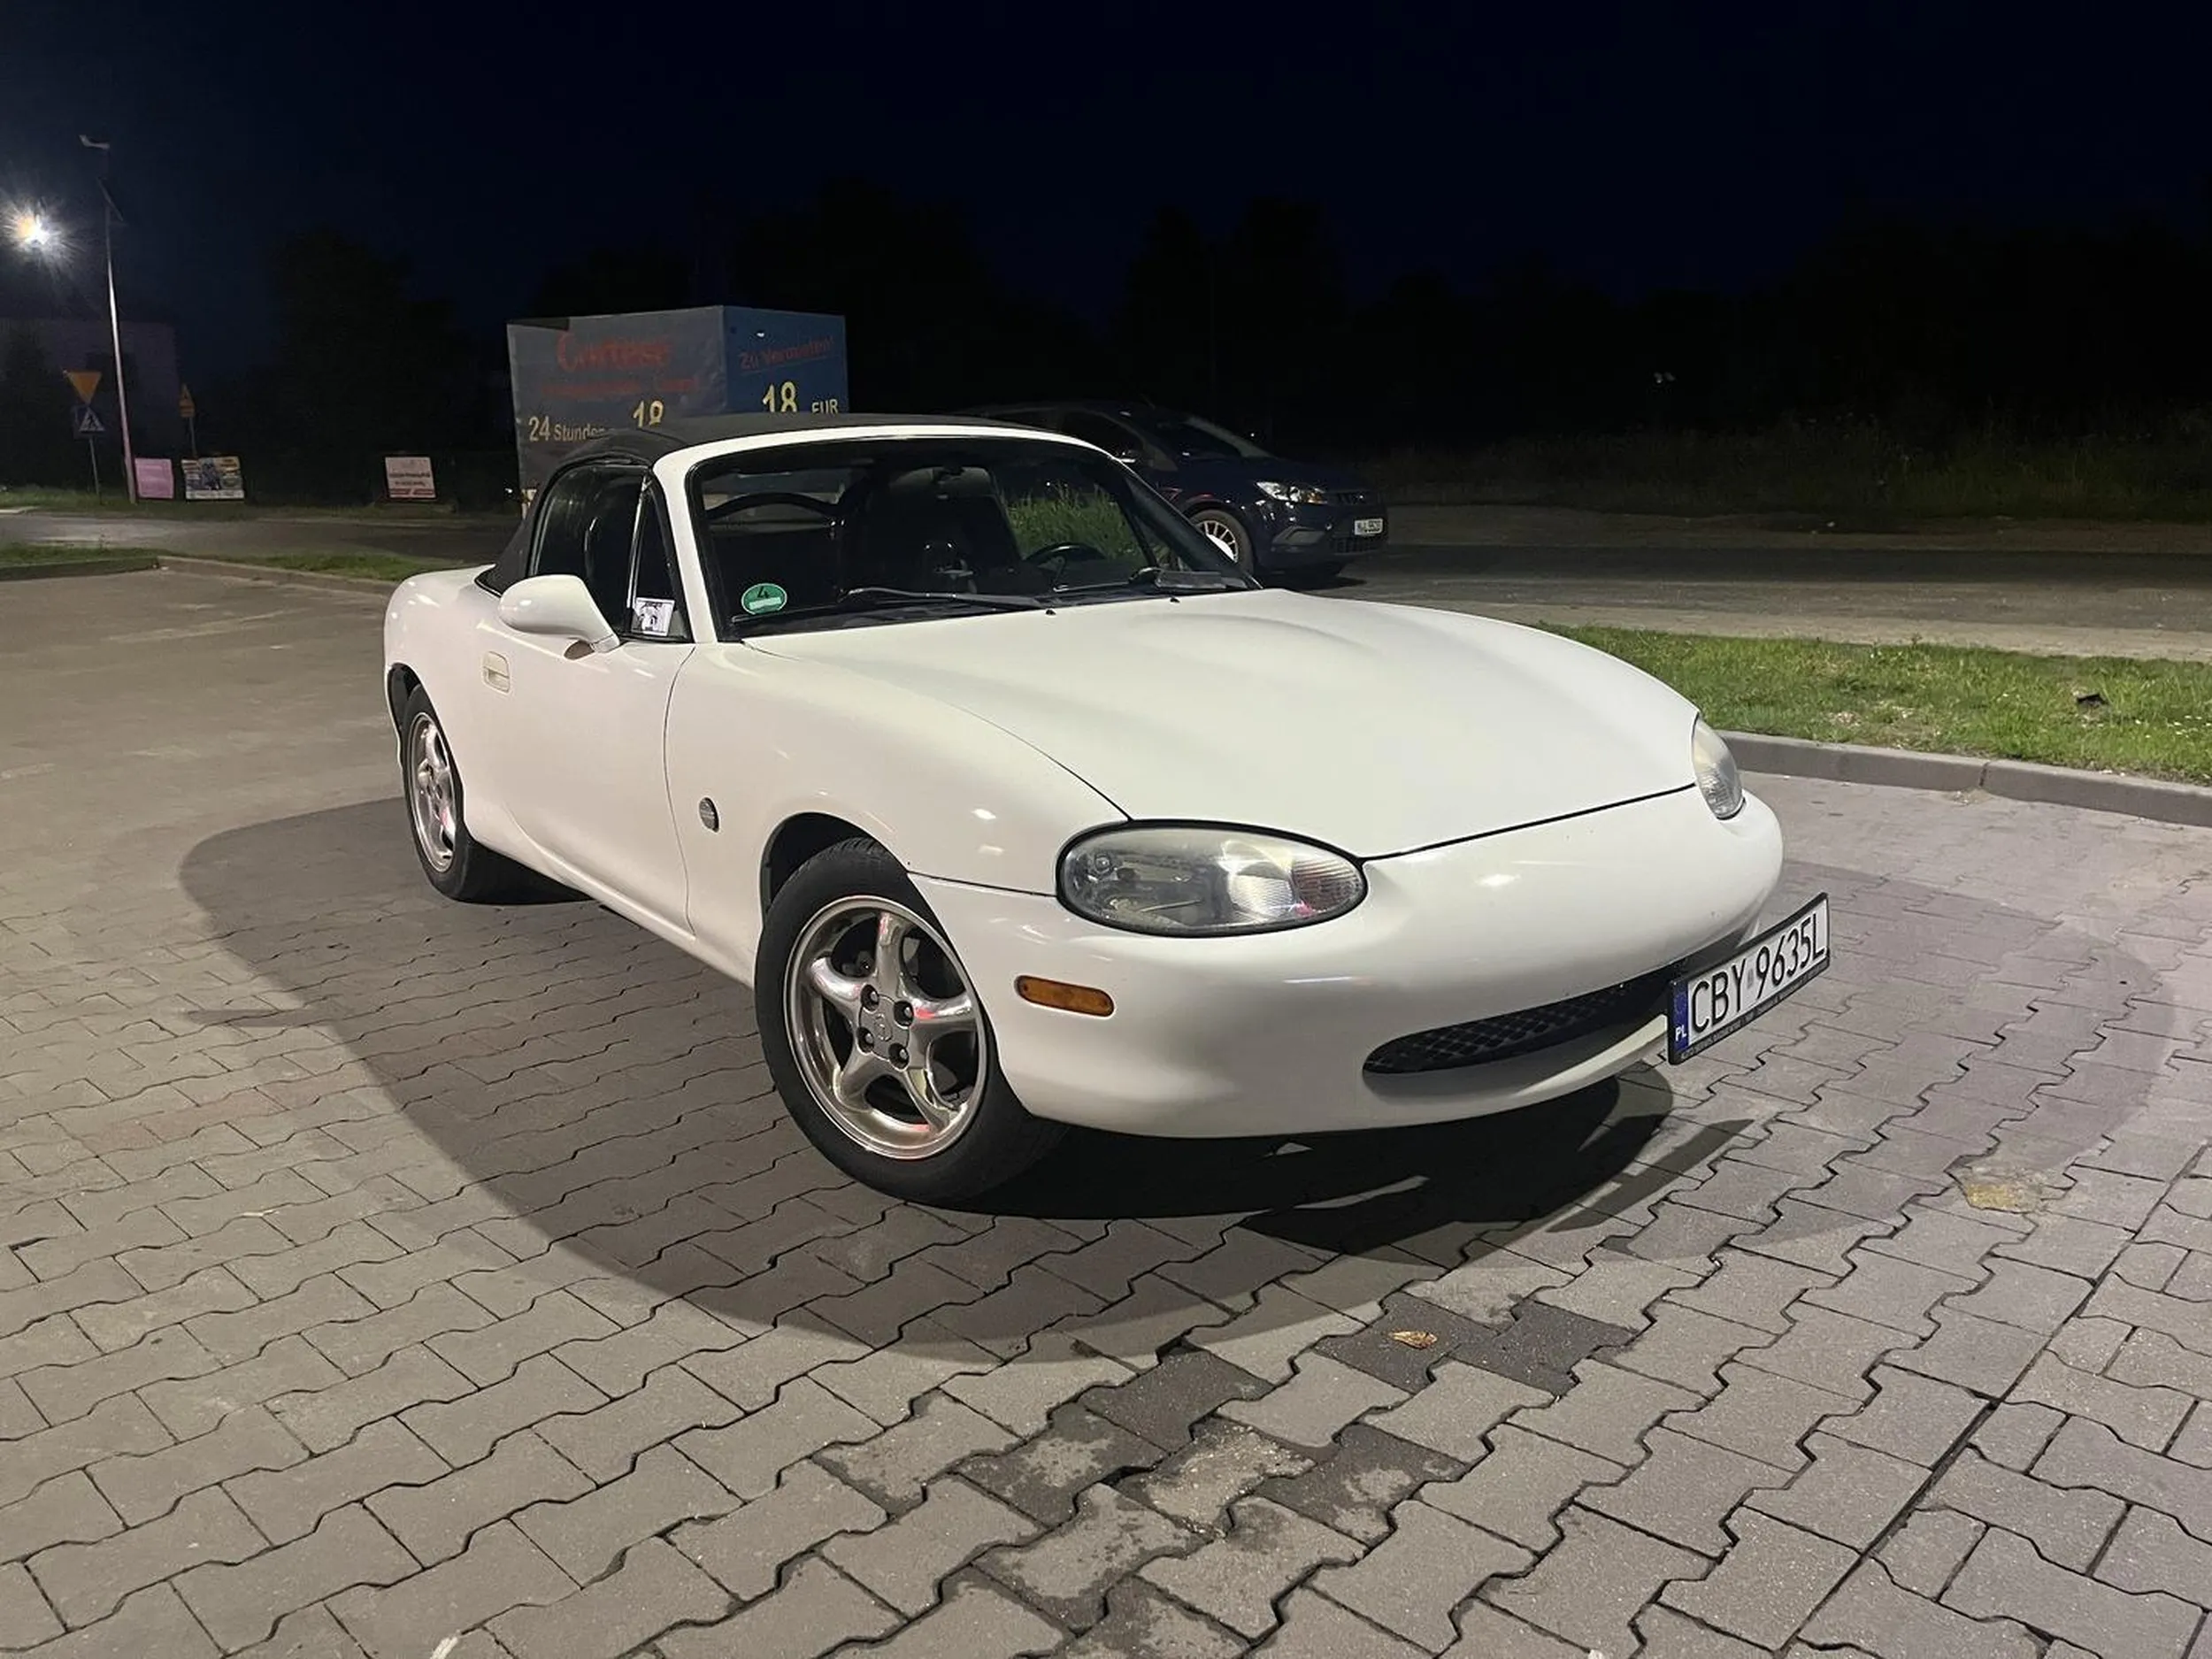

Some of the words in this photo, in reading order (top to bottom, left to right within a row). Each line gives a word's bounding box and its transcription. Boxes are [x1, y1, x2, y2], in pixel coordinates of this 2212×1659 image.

[762, 380, 798, 413] 18
[811, 398, 839, 414] EUR
[527, 415, 550, 442] 24
[757, 586, 770, 599] 4
[1675, 1024, 1687, 1042] PL
[1691, 957, 1747, 1034] CBY
[1755, 913, 1826, 1000] 9635L
